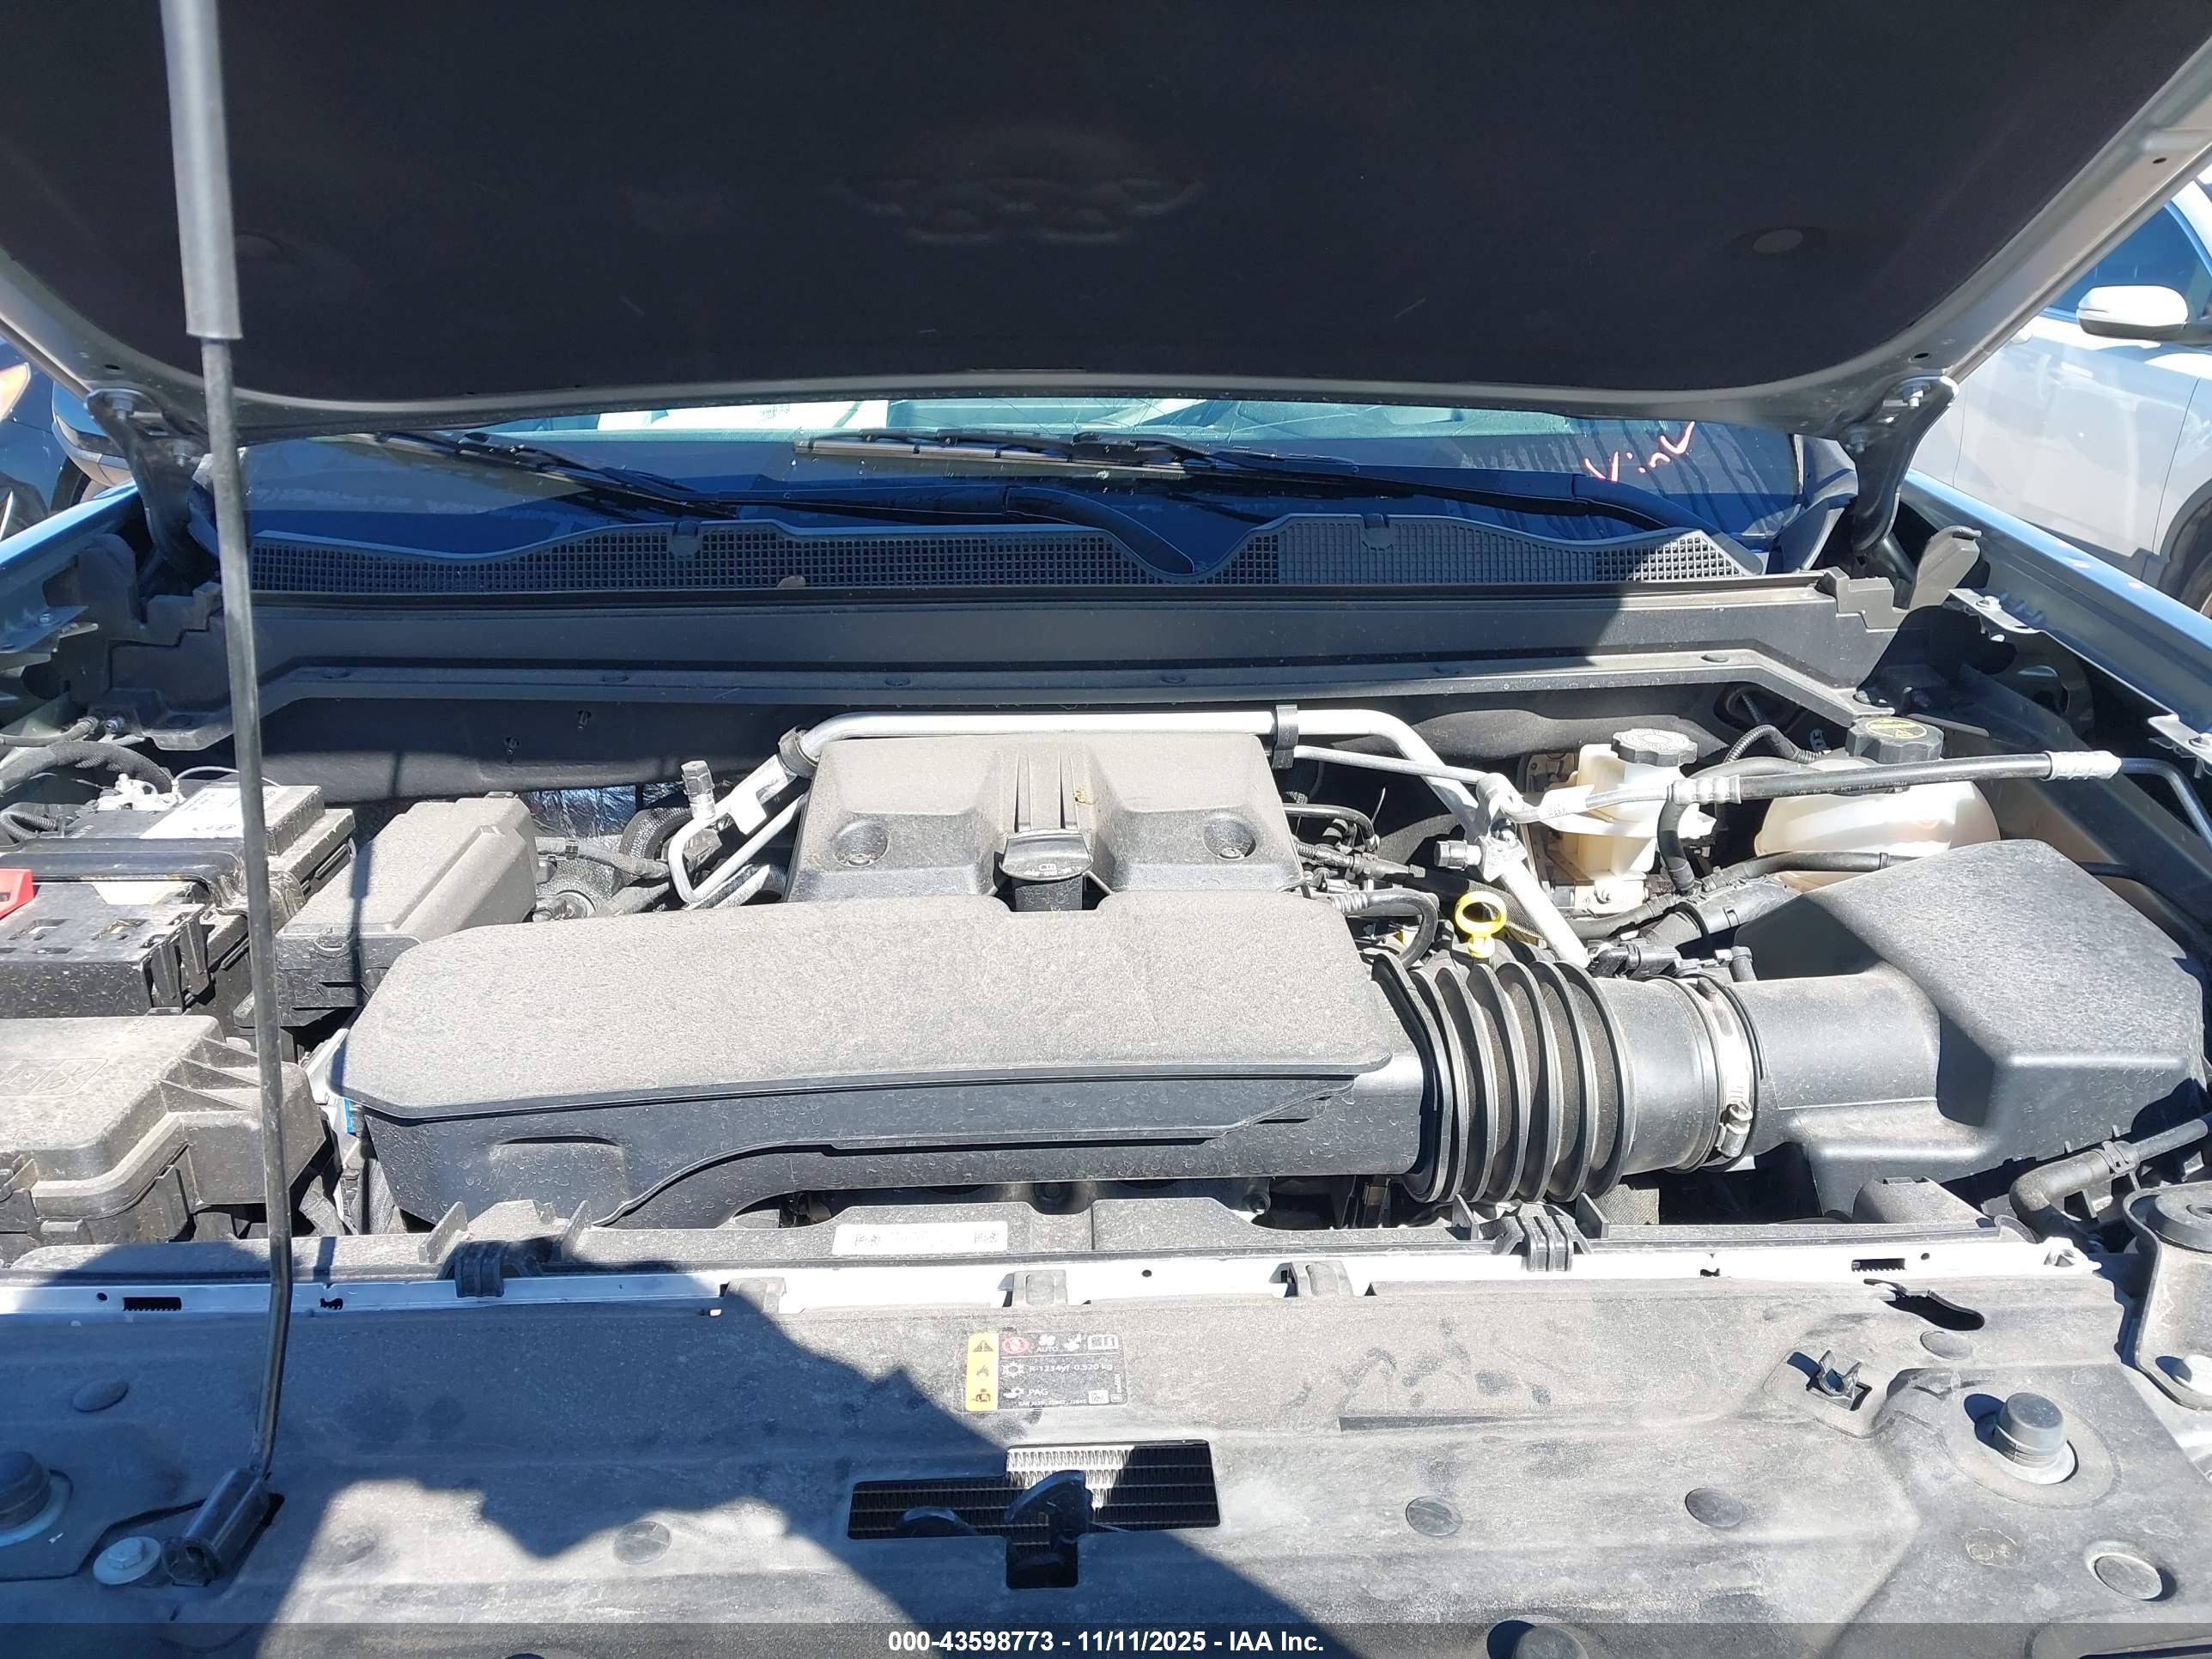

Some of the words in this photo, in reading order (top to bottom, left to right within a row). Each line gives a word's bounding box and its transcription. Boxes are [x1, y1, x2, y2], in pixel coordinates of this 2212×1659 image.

[1029, 1363, 1071, 1373] R-1234yf
[1073, 1363, 1099, 1371] 0.520
[1100, 1363, 1114, 1372] kg
[1028, 1388, 1048, 1396] PAG
